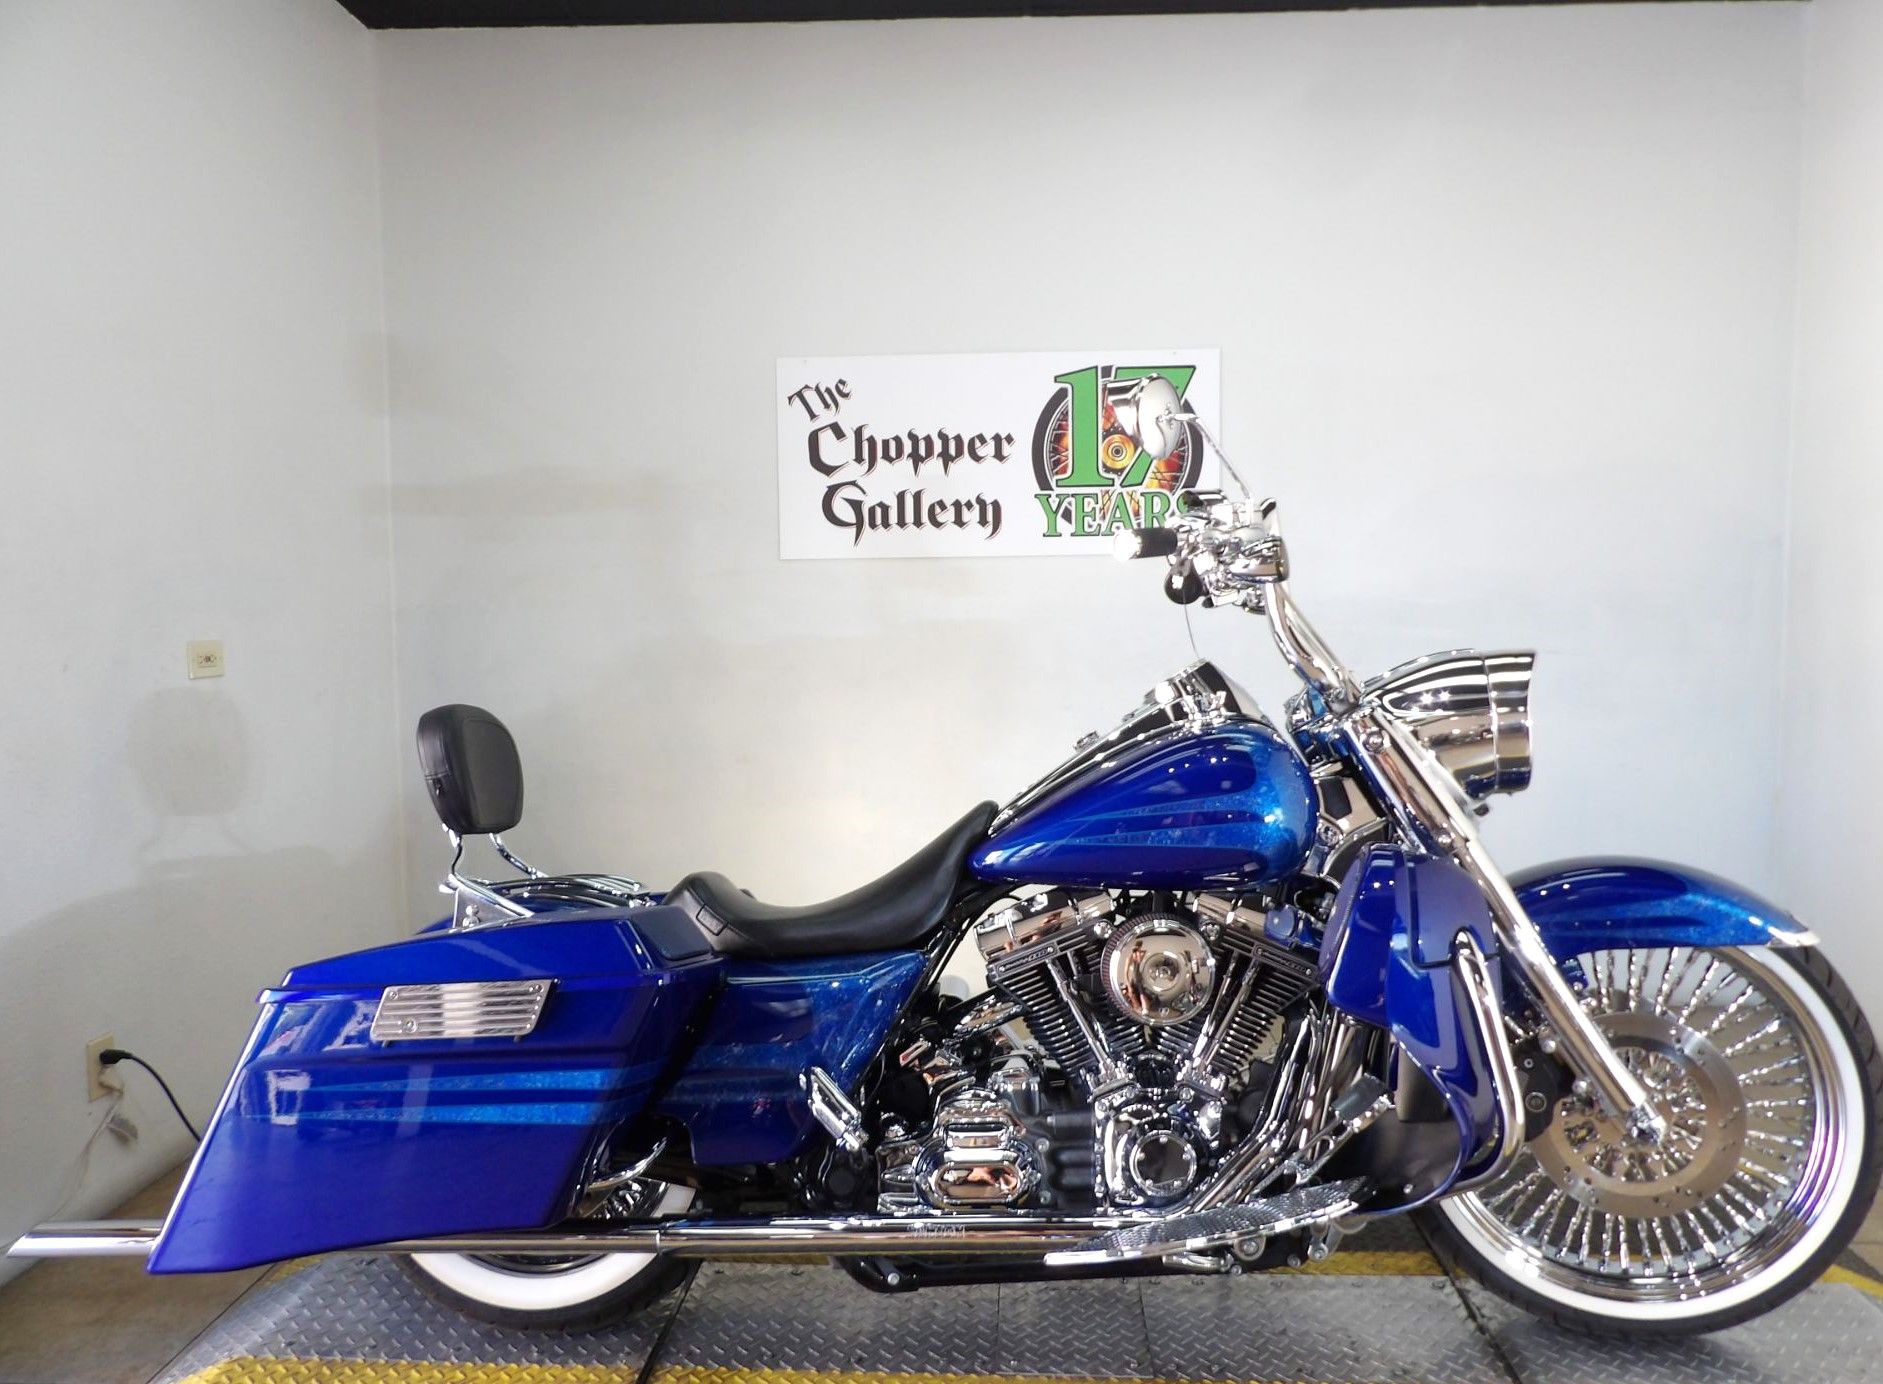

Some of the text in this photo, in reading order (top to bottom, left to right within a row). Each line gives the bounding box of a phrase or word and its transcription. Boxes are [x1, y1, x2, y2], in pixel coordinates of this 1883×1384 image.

[787, 376, 853, 424] The
[1054, 365, 1197, 488] 17
[807, 421, 1016, 478] Chopper
[821, 479, 1002, 547] Gallery
